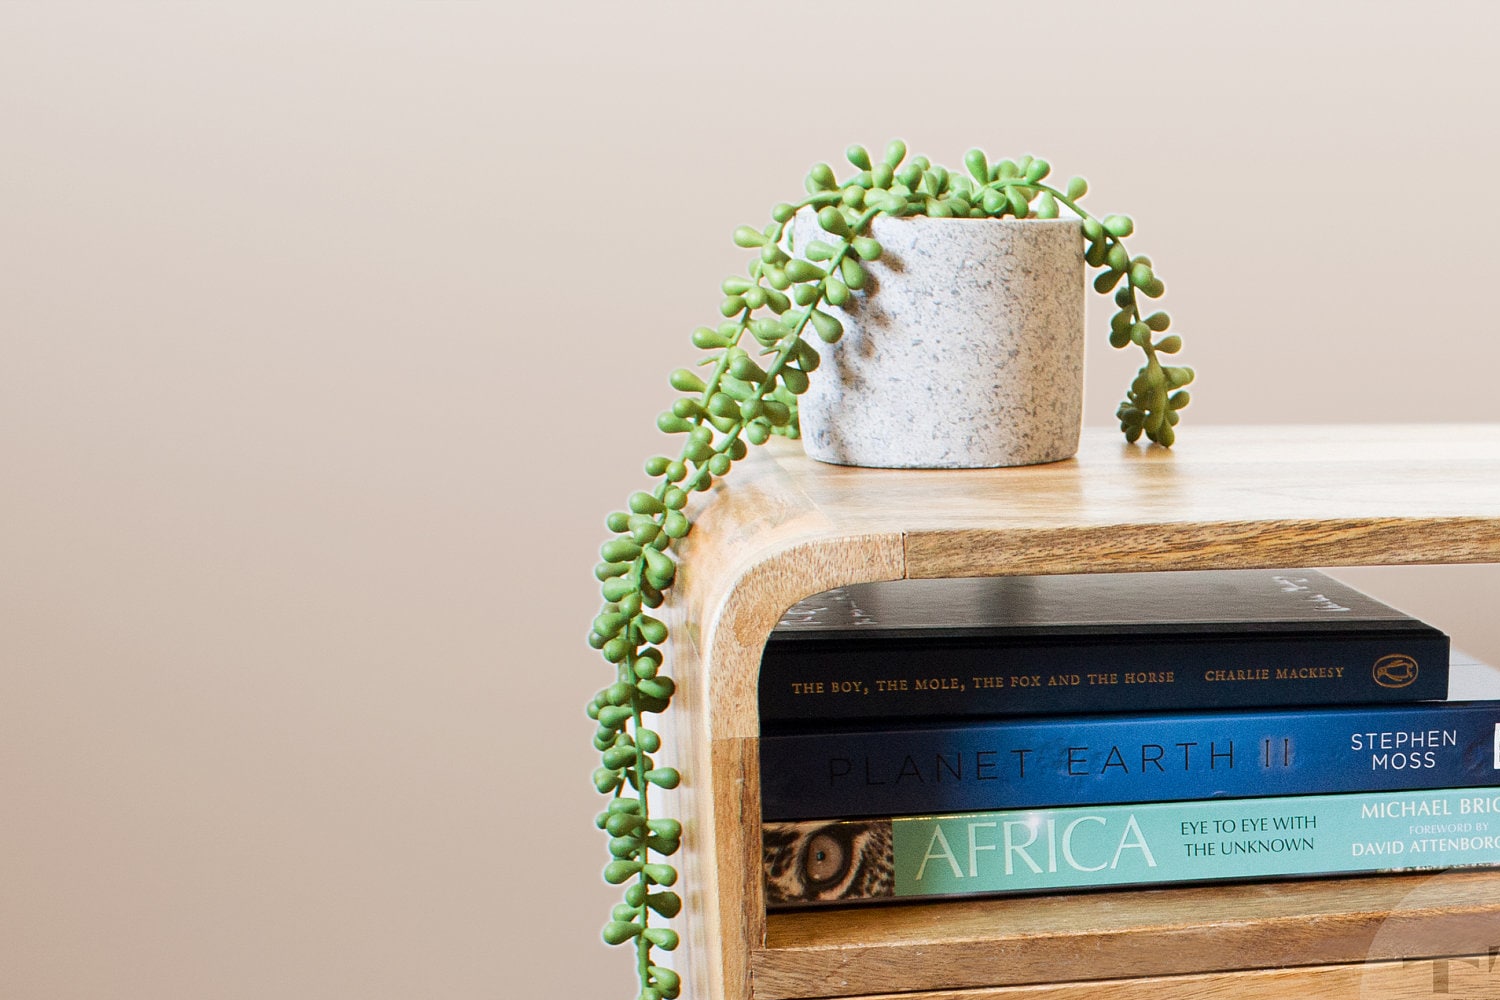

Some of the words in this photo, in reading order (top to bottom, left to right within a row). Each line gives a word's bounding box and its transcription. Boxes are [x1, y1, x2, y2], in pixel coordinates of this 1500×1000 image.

[792, 682, 825, 694] THE
[831, 681, 869, 695] BOY,
[876, 680, 908, 692] THE
[915, 678, 966, 692] MOLE,
[973, 677, 1004, 689] THE
[1010, 676, 1041, 688] FOX
[1048, 674, 1080, 686] AND
[1087, 673, 1118, 685] THE
[1124, 671, 1175, 684] HORSE
[1204, 668, 1270, 682] CHARLIE
[1275, 666, 1345, 680] MACKESY
[1351, 729, 1458, 750] STEPHEN
[829, 748, 1033, 787] PLANET
[1067, 740, 1235, 777] EARTH
[1264, 738, 1290, 768] II
[1371, 751, 1436, 771] MOSS
[1361, 798, 1452, 819] MICHAEL
[1180, 820, 1208, 836] EYE
[1212, 819, 1236, 834] TO
[1241, 817, 1269, 833] EYE
[1272, 814, 1317, 831] WITH
[1409, 822, 1472, 835] FOREWORD
[1475, 822, 1489, 832] BY
[915, 813, 1158, 882] AFRICA
[1184, 841, 1216, 857] THE
[1220, 837, 1315, 856] UNKNOWN
[1352, 840, 1404, 857] DAVID
